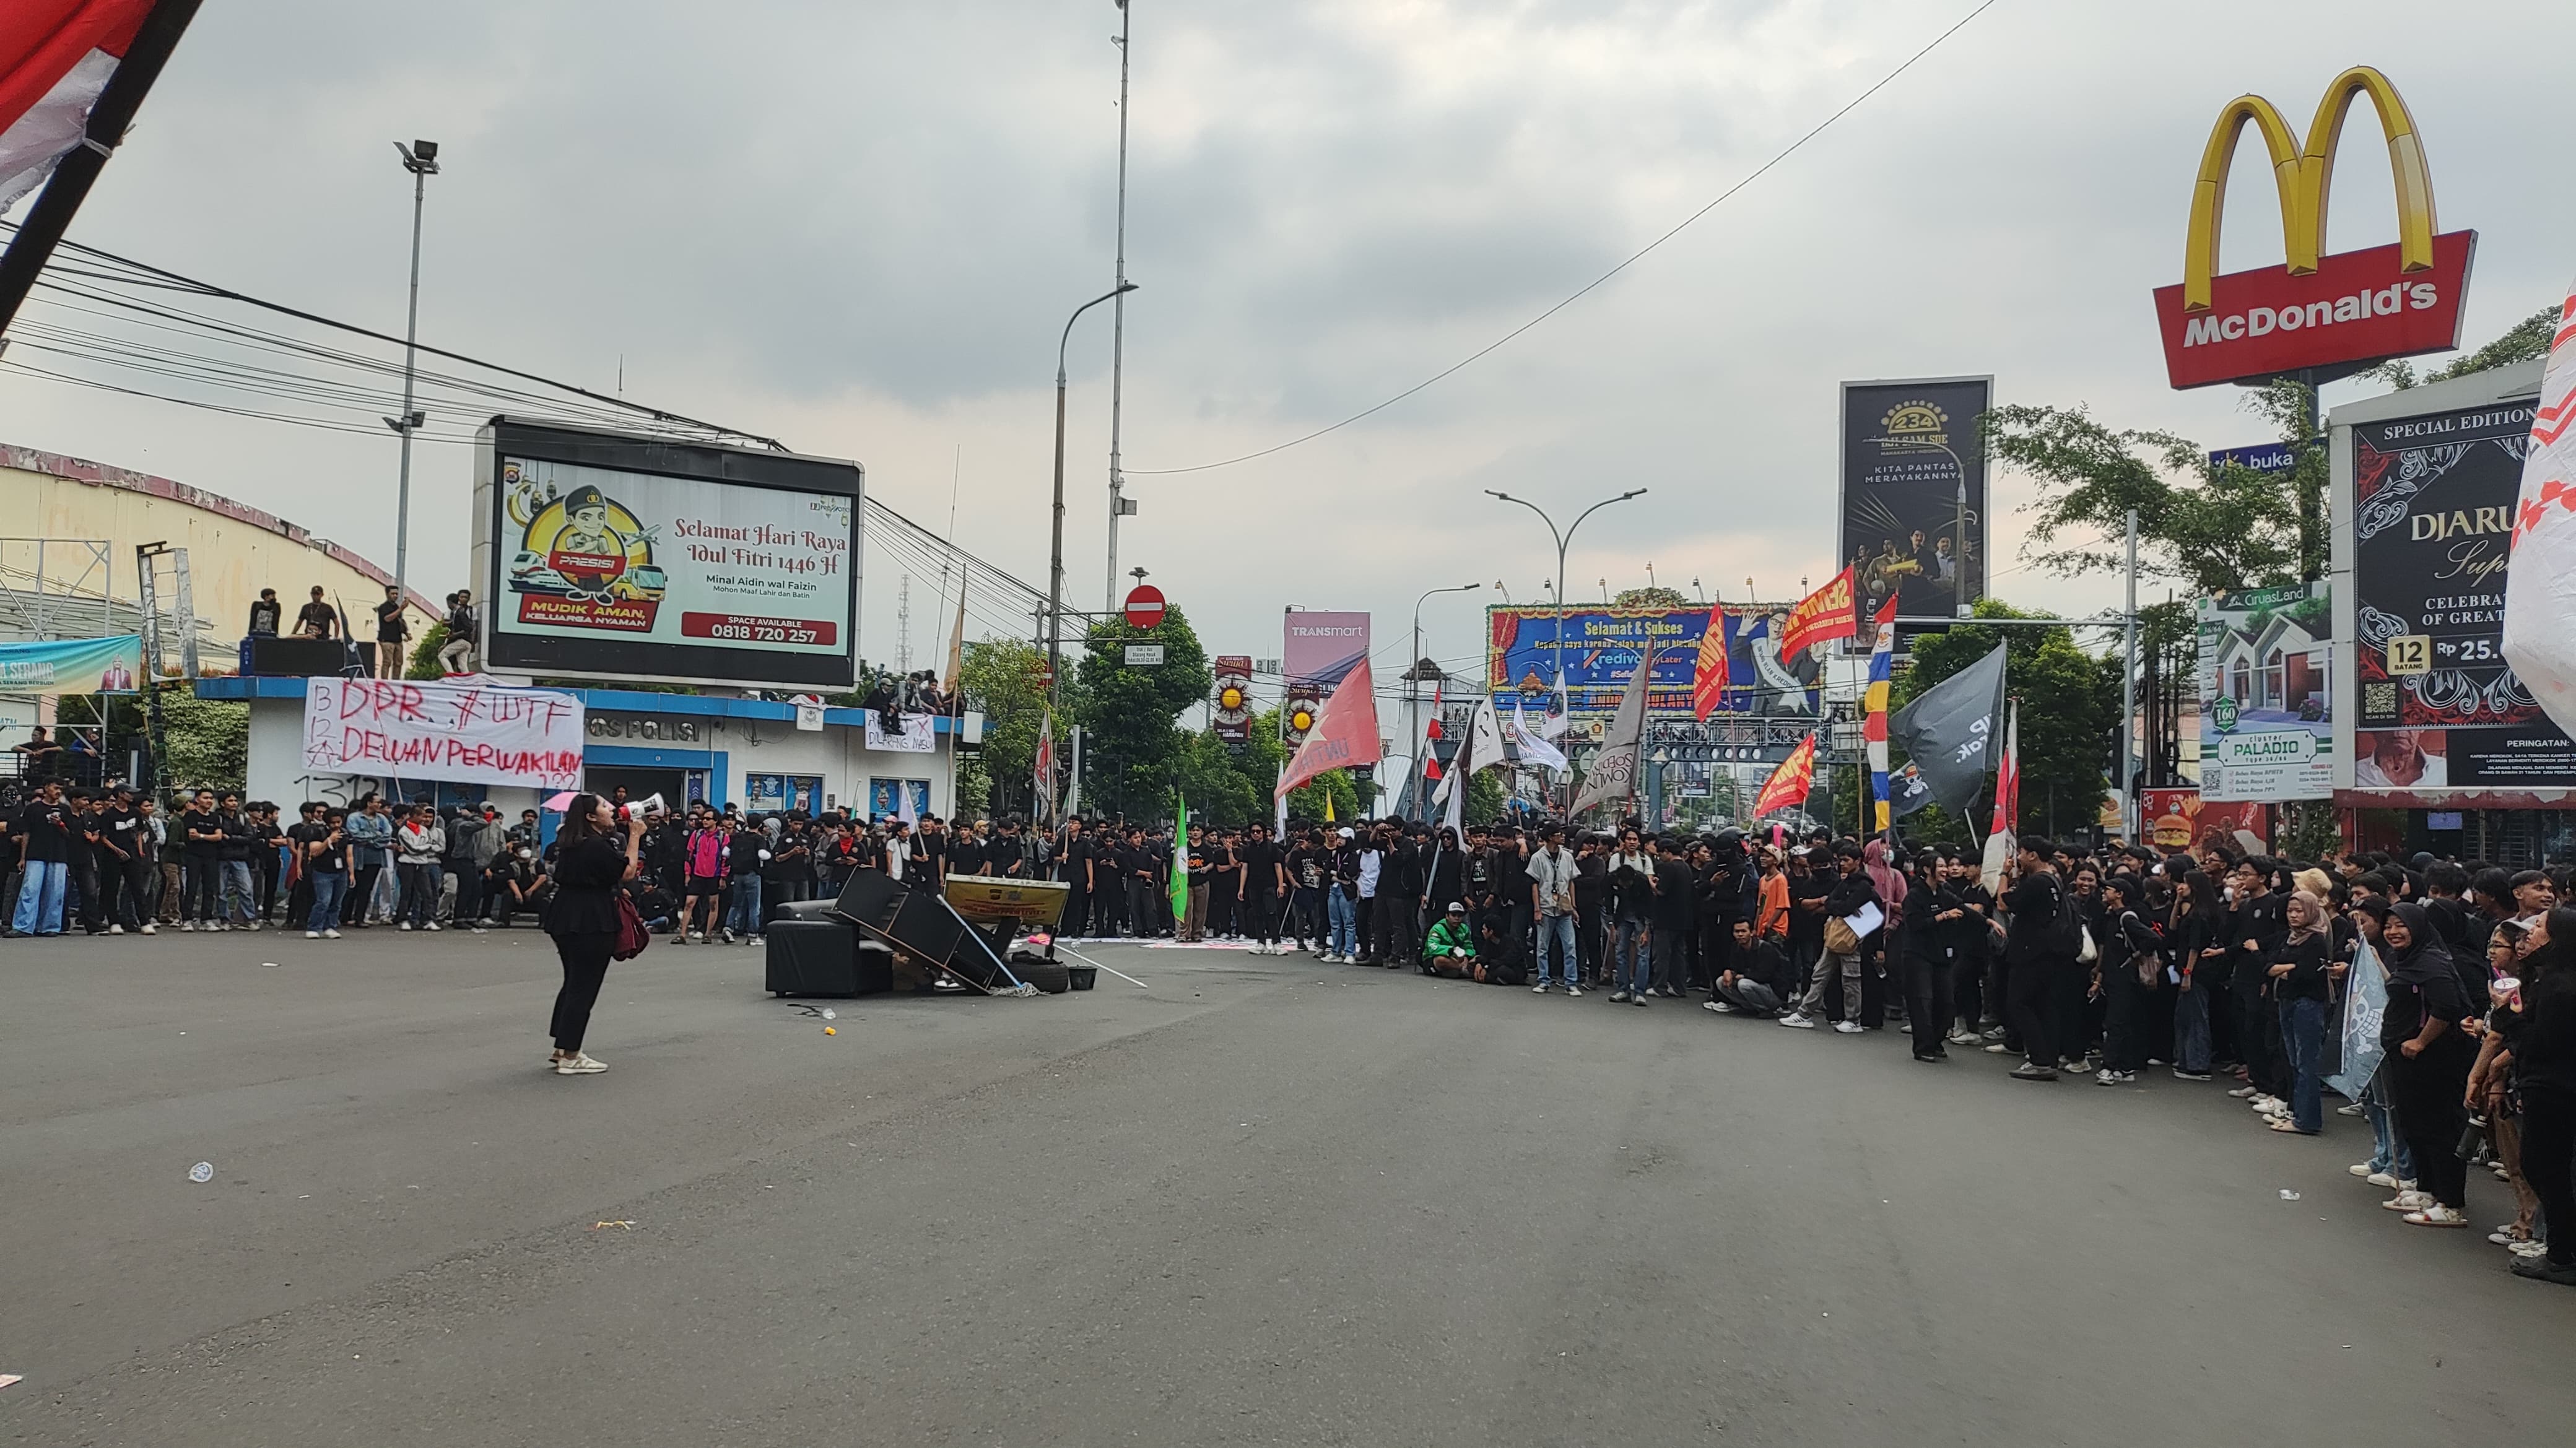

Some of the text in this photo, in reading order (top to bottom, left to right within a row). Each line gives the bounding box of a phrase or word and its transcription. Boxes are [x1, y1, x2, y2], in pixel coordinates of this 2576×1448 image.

[2183, 281, 2438, 348] McDonald's
[1895, 415, 1934, 429] 234
[2384, 407, 2537, 440] SPECIAL EDITION
[1875, 463, 1955, 474] KITA PANTAS
[2250, 452, 2294, 469] buka
[2411, 505, 2516, 542] DJARU
[674, 518, 846, 553] Selamat Hari Raya
[559, 555, 616, 569] PRESISI
[687, 544, 841, 576] Idul Fitri 1446 H
[2434, 540, 2509, 587] Sup
[706, 574, 817, 591] Minal Aidin wal Faizin
[531, 602, 645, 619] MUDIK AMAN,
[526, 612, 646, 627] KELUARGA NYAMAN
[728, 616, 802, 628] SPACE AVAILABLE
[2422, 613, 2445, 626] OF
[712, 624, 817, 643] 0818 720 257
[1585, 621, 1683, 636] Selamat & Sukses
[2395, 641, 2422, 662] 12
[2437, 643, 2456, 657] Rp
[10, 662, 54, 680] SERANG
[2217, 708, 2235, 721] 160
[585, 717, 700, 742] OS POLISI
[341, 726, 583, 774] DEWAN PERWAKILAN
[2234, 741, 2299, 756] PALADIO
[2507, 739, 2570, 747] PERINGATAN:
